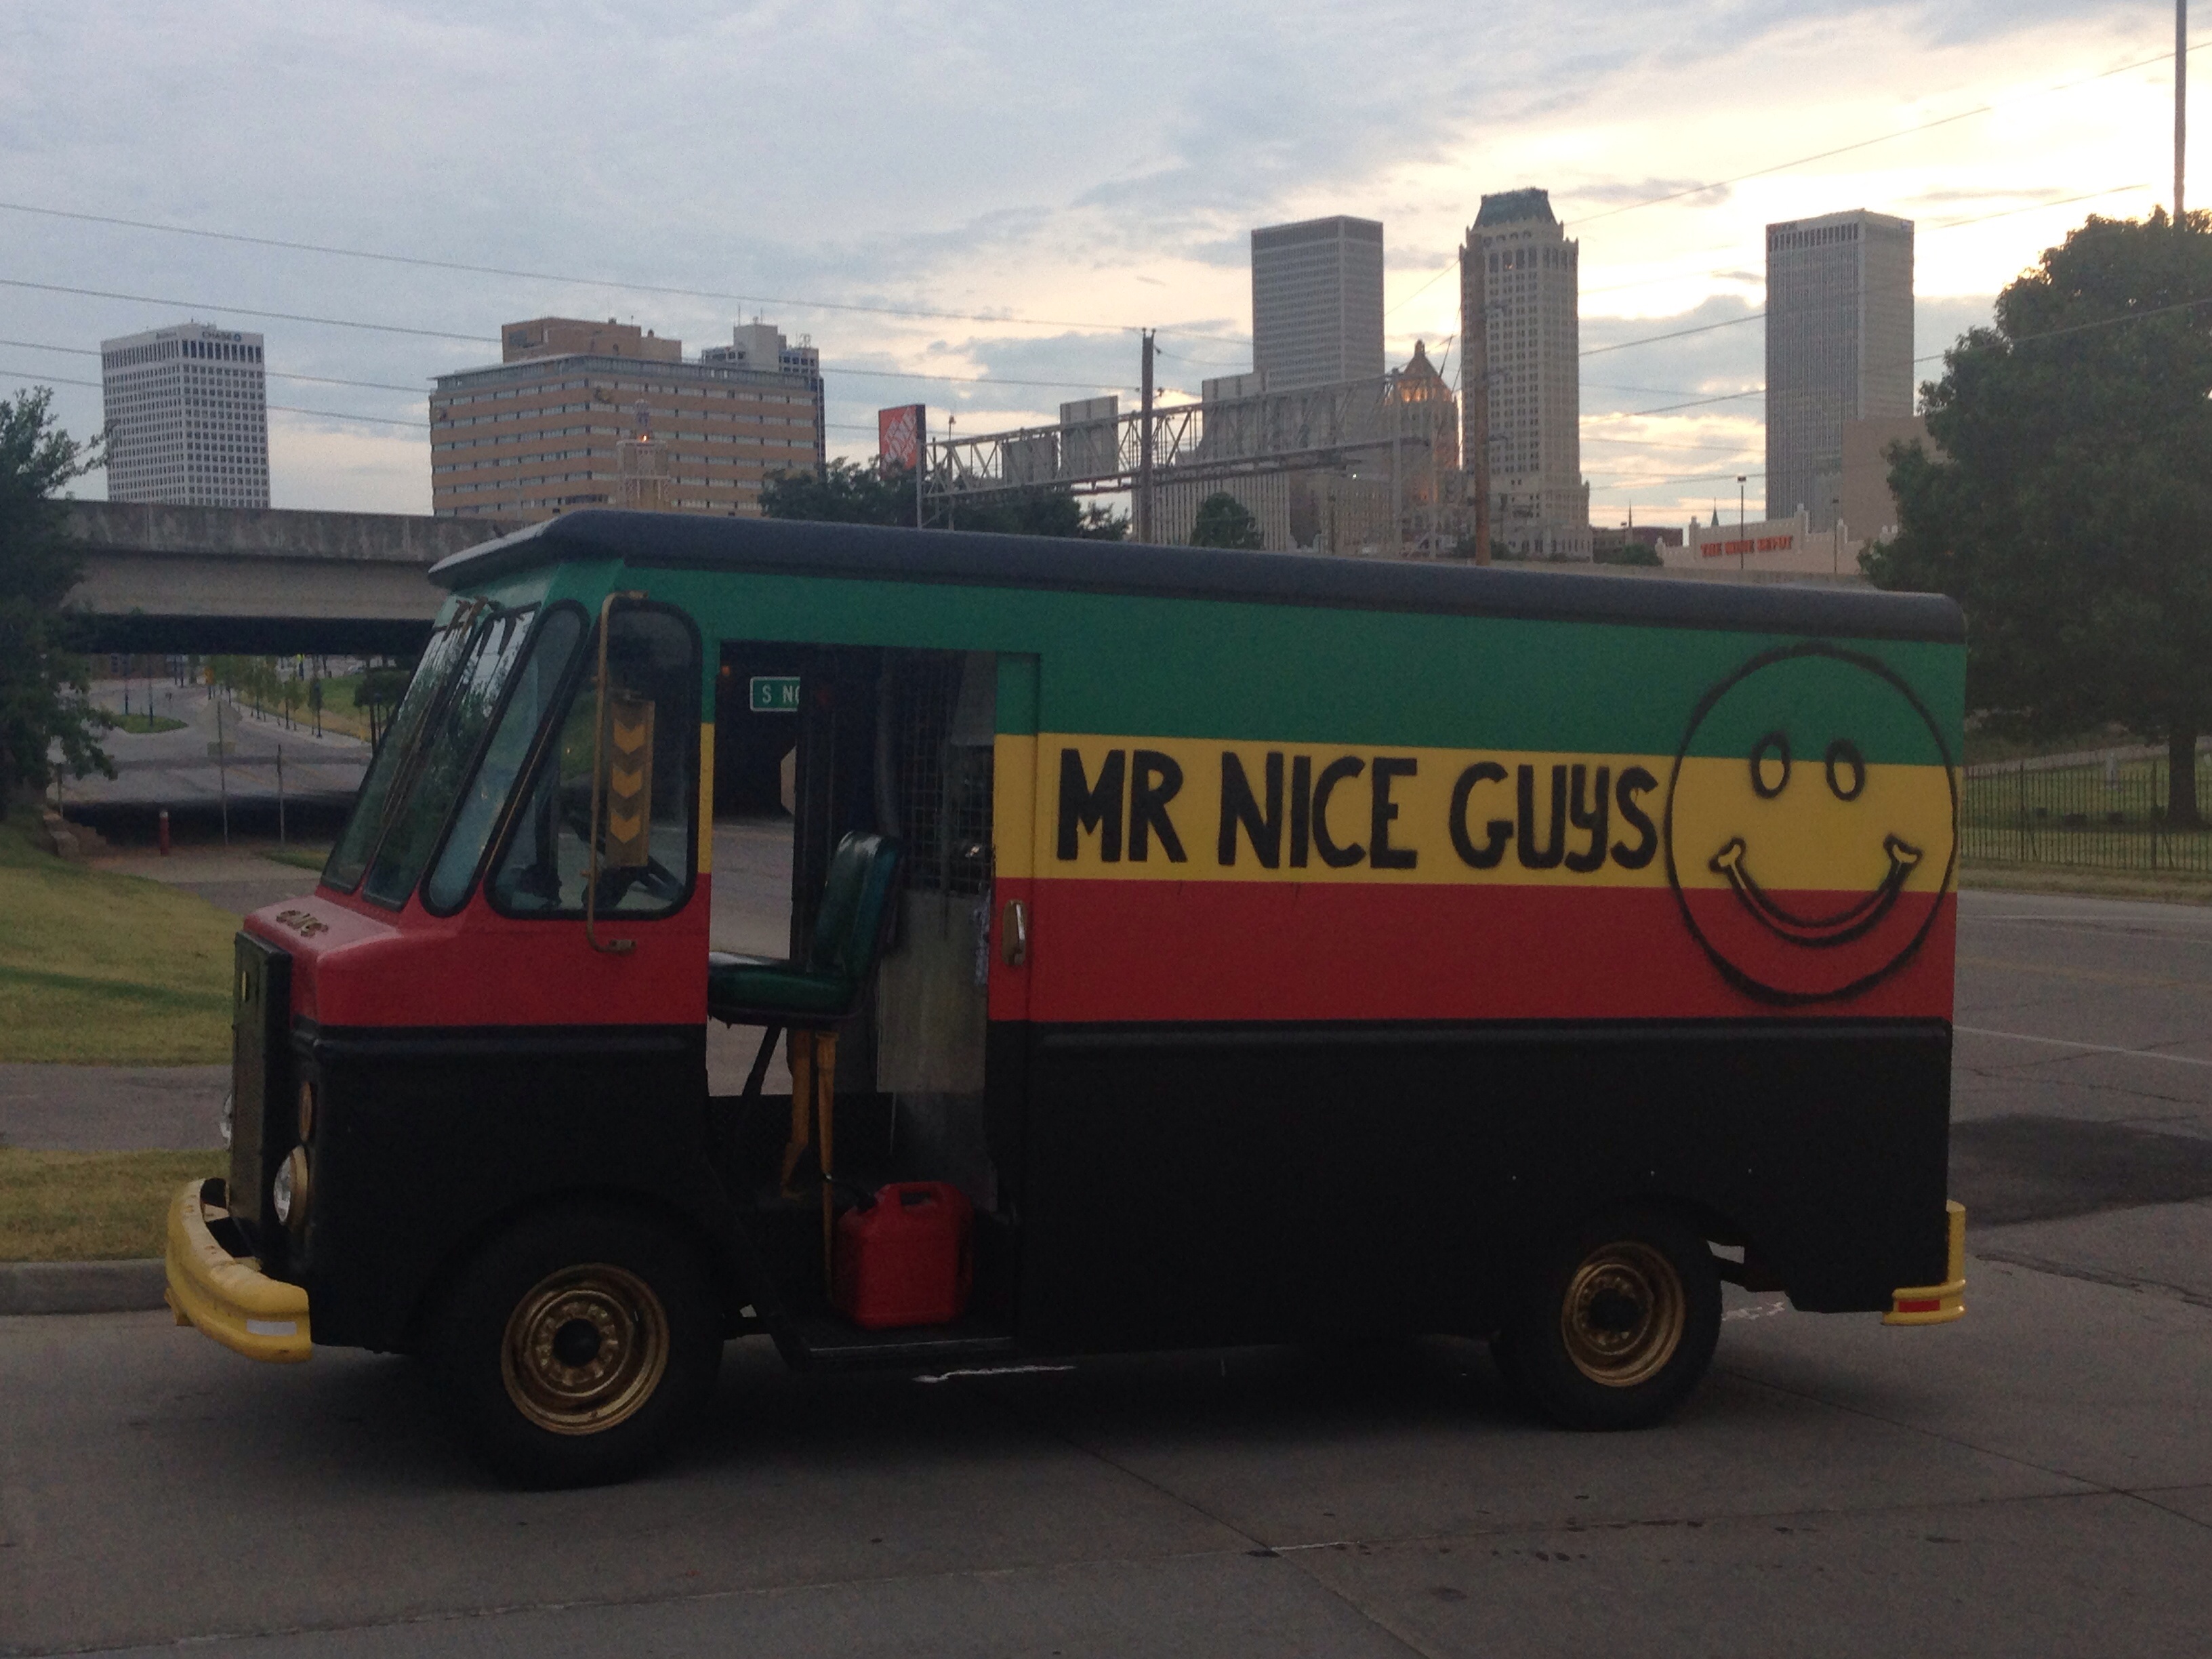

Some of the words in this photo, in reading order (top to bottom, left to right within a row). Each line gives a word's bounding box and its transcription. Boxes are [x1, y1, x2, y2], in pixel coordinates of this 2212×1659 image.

[762, 684, 772, 703] S
[1057, 748, 1187, 863] MR
[1218, 751, 1418, 869] NICE
